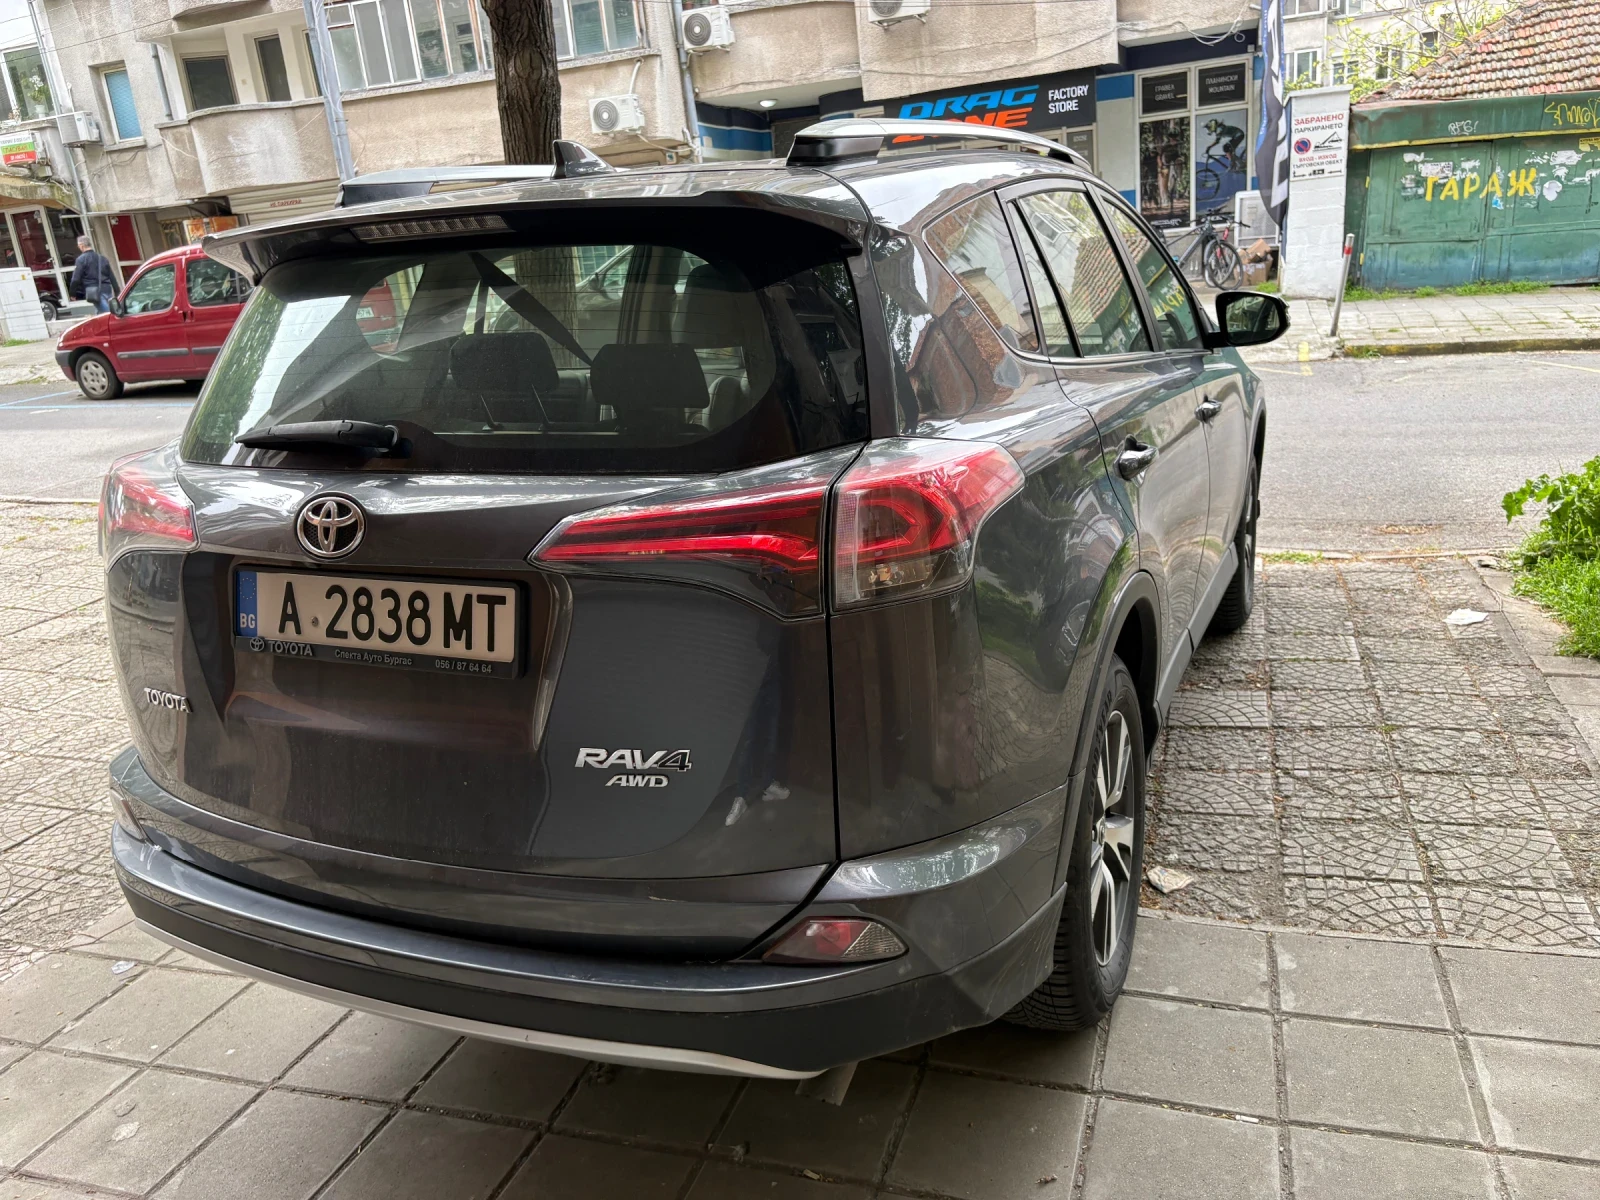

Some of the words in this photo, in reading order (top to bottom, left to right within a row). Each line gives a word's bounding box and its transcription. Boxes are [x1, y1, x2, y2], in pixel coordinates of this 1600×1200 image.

[1048, 84, 1089, 102] FACTORY
[898, 84, 1040, 120] DRAG
[1048, 99, 1080, 114] STORE
[1294, 113, 1344, 126] ЗАБРАНЕНО
[1294, 122, 1343, 133] ПАРКИРАНЕТО
[1425, 167, 1537, 202] ГАРАЖ
[239, 612, 256, 629] BG
[278, 581, 302, 635] A
[325, 584, 431, 646] 2838
[443, 591, 507, 652] MT
[268, 640, 313, 657] TOYOTA
[334, 649, 362, 661] Спекта
[363, 651, 382, 664] Ауто
[384, 654, 412, 666] Бургас
[435, 659, 450, 669] 056
[456, 661, 467, 671] 87
[469, 662, 479, 672] 64
[481, 663, 492, 673] 64
[143, 687, 190, 714] TOYOTA
[574, 747, 692, 772] RAV4
[605, 774, 669, 788] AWD
